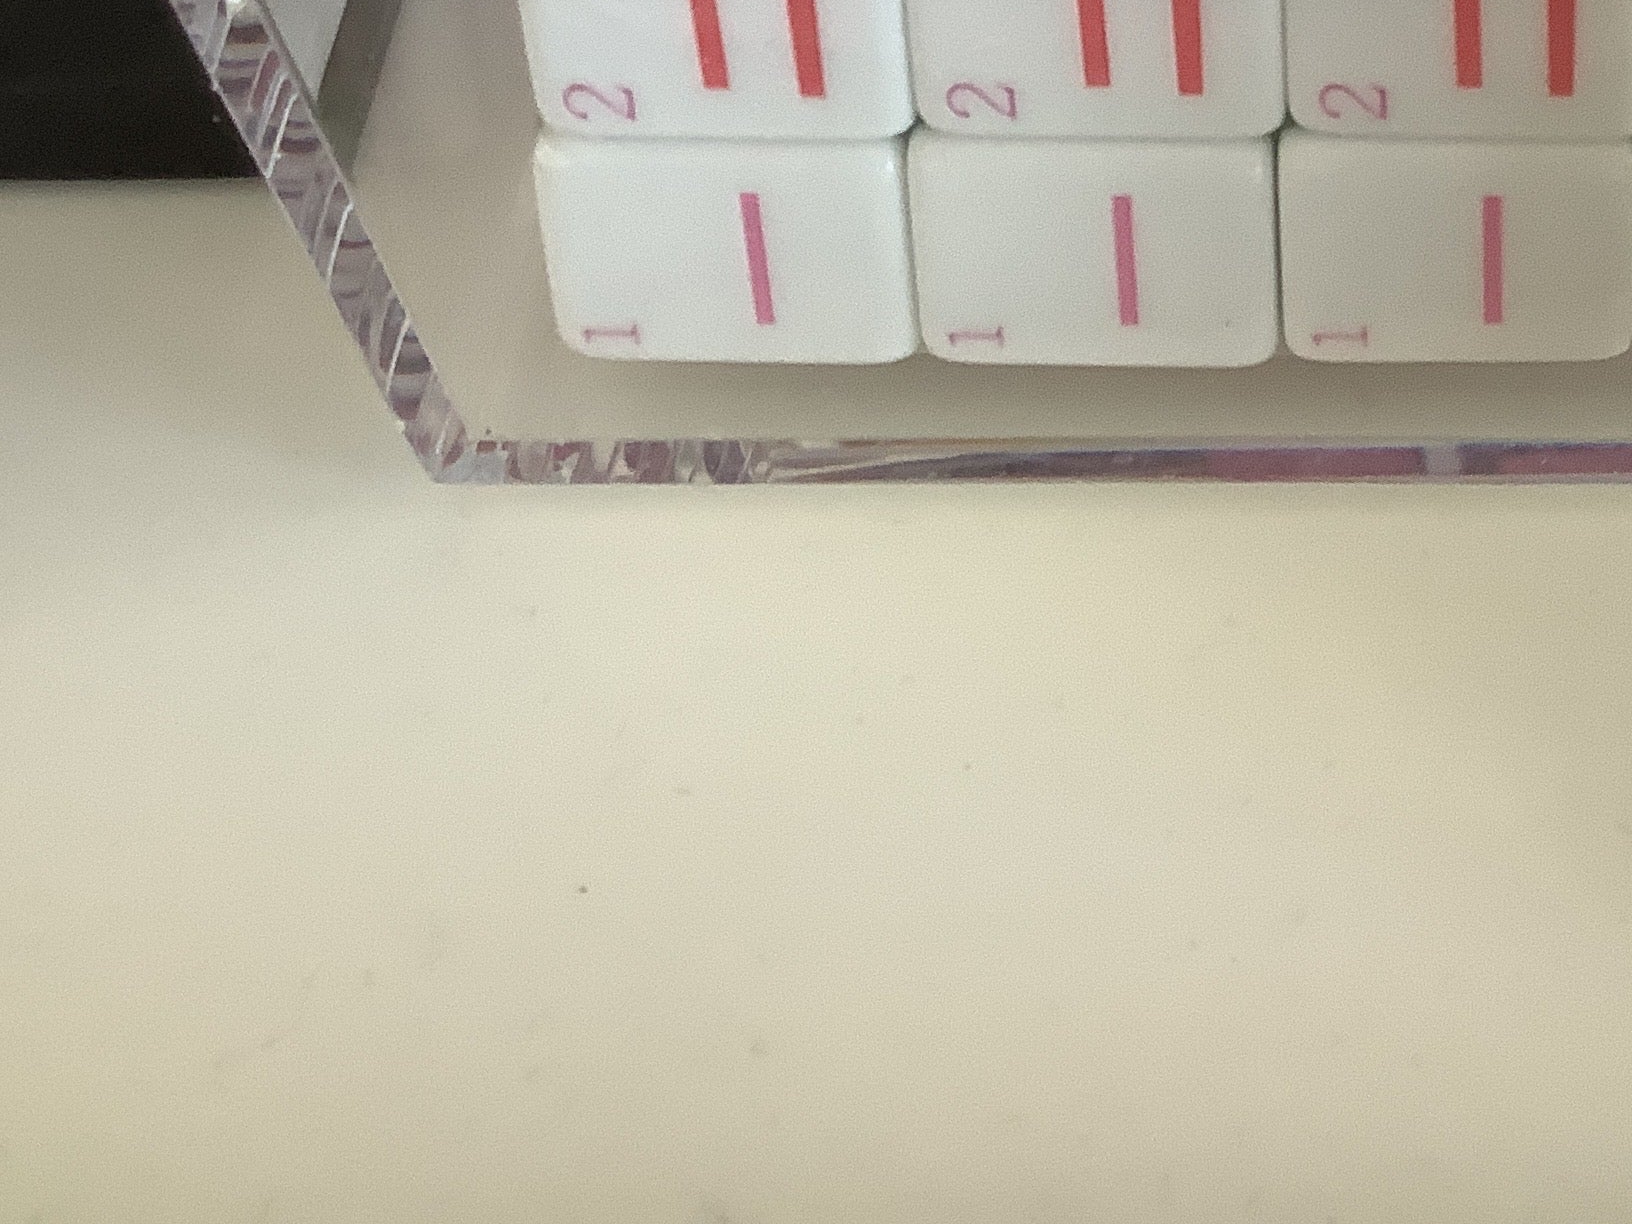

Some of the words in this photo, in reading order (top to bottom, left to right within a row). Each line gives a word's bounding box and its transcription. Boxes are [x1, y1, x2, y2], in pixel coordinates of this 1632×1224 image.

[562, 82, 637, 122] 2
[946, 82, 1018, 121] 2
[1319, 83, 1389, 121] 2
[583, 323, 641, 345] 1
[948, 325, 1005, 347] 1
[1311, 325, 1369, 347] 1
